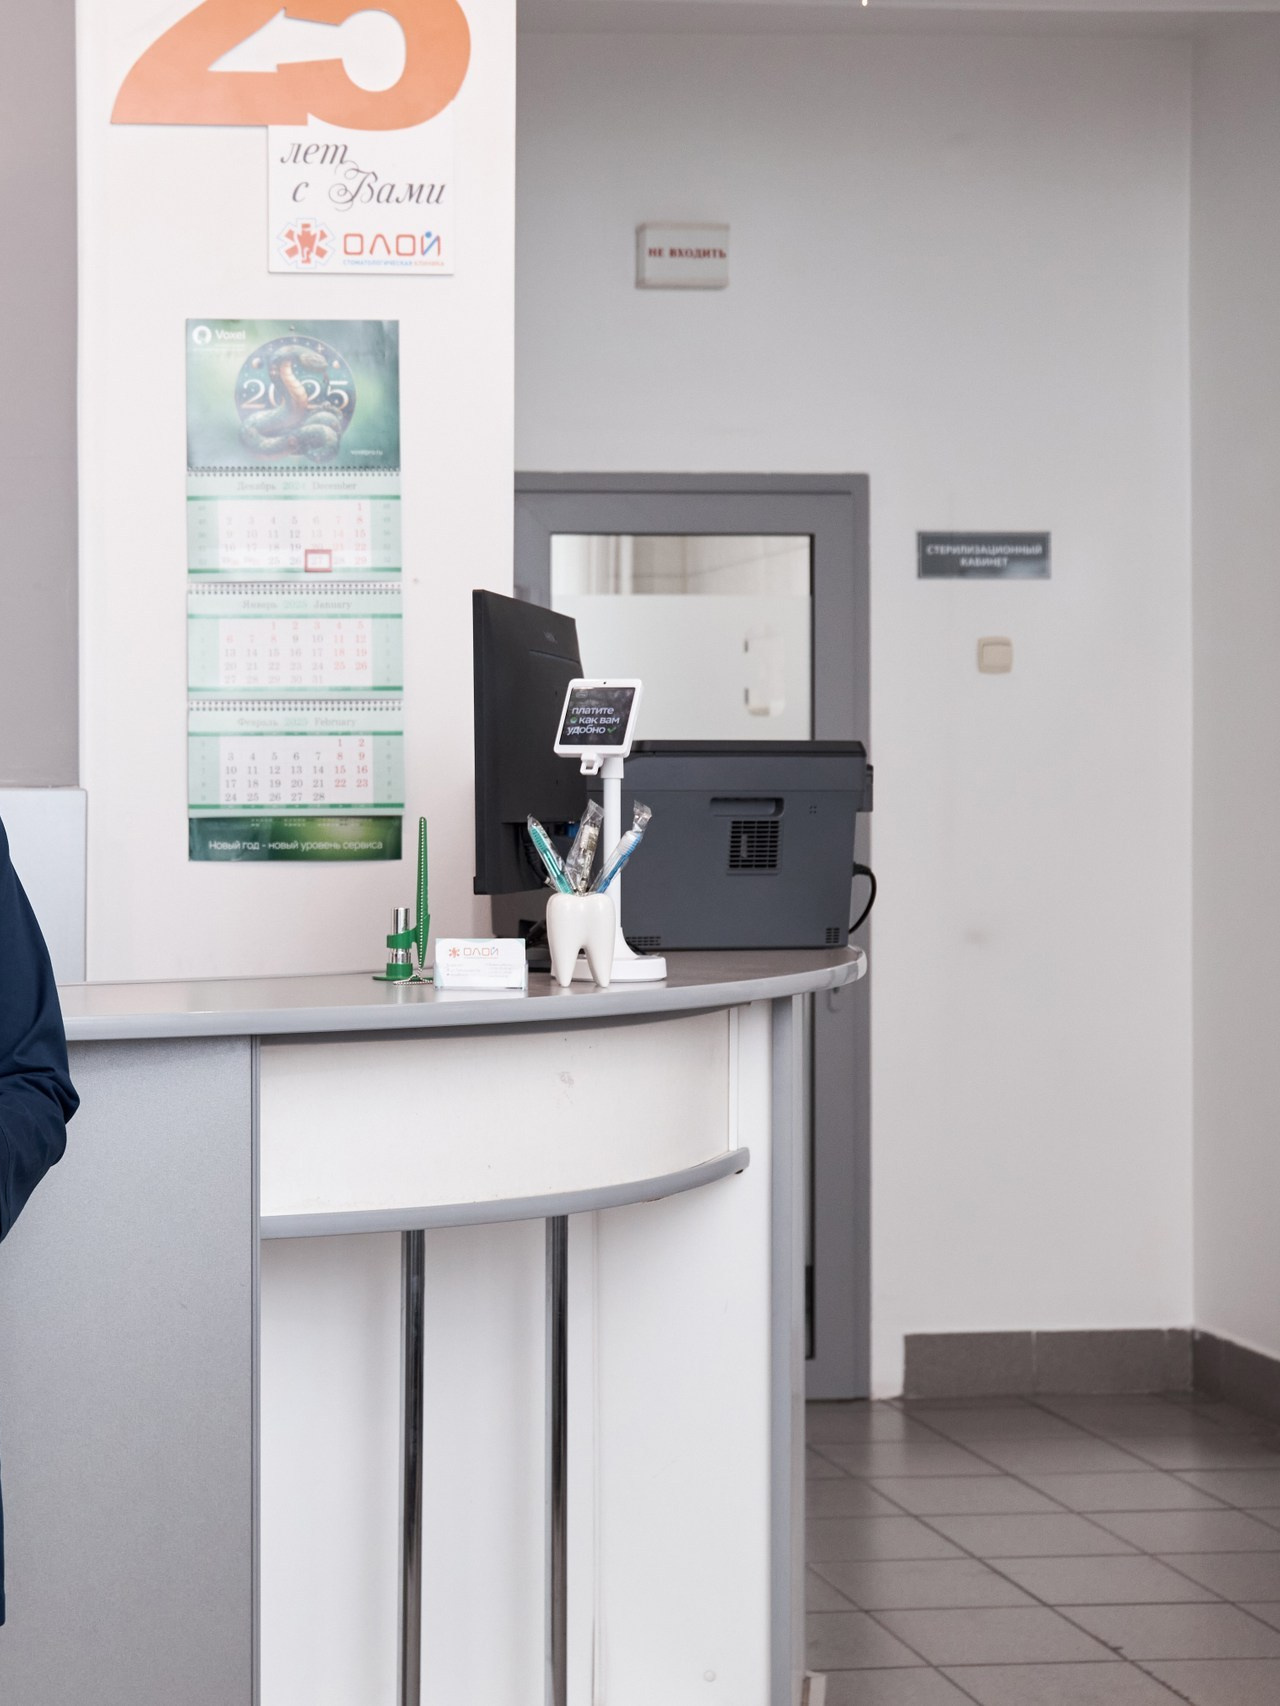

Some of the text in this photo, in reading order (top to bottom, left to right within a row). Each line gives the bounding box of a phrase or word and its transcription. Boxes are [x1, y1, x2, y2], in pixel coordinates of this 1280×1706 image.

[280, 142, 349, 165] лет
[292, 160, 446, 212] с Вами
[343, 231, 441, 256] ОЛОЙ
[648, 248, 727, 258] НЕ ВХОДИТЬ
[290, 529, 300, 539] 12
[927, 544, 1043, 555] СТЕРИЛИЗАЦИОННЫЙ
[960, 557, 1008, 567] КАБИНЕТ
[567, 725, 605, 735] удобно
[338, 738, 365, 747] 1 2
[227, 751, 365, 761] 3 4 5 6 7 8 9
[226, 765, 368, 775] 10 11 12 13 14 15 16
[225, 778, 368, 788] 17 18 19 20 21 22 23
[225, 792, 325, 802] 24 25 26 27 28
[209, 840, 240, 850] Новый
[243, 842, 260, 850] год
[268, 840, 298, 850] новый
[301, 842, 341, 852] уровень
[343, 842, 383, 851] сервиса
